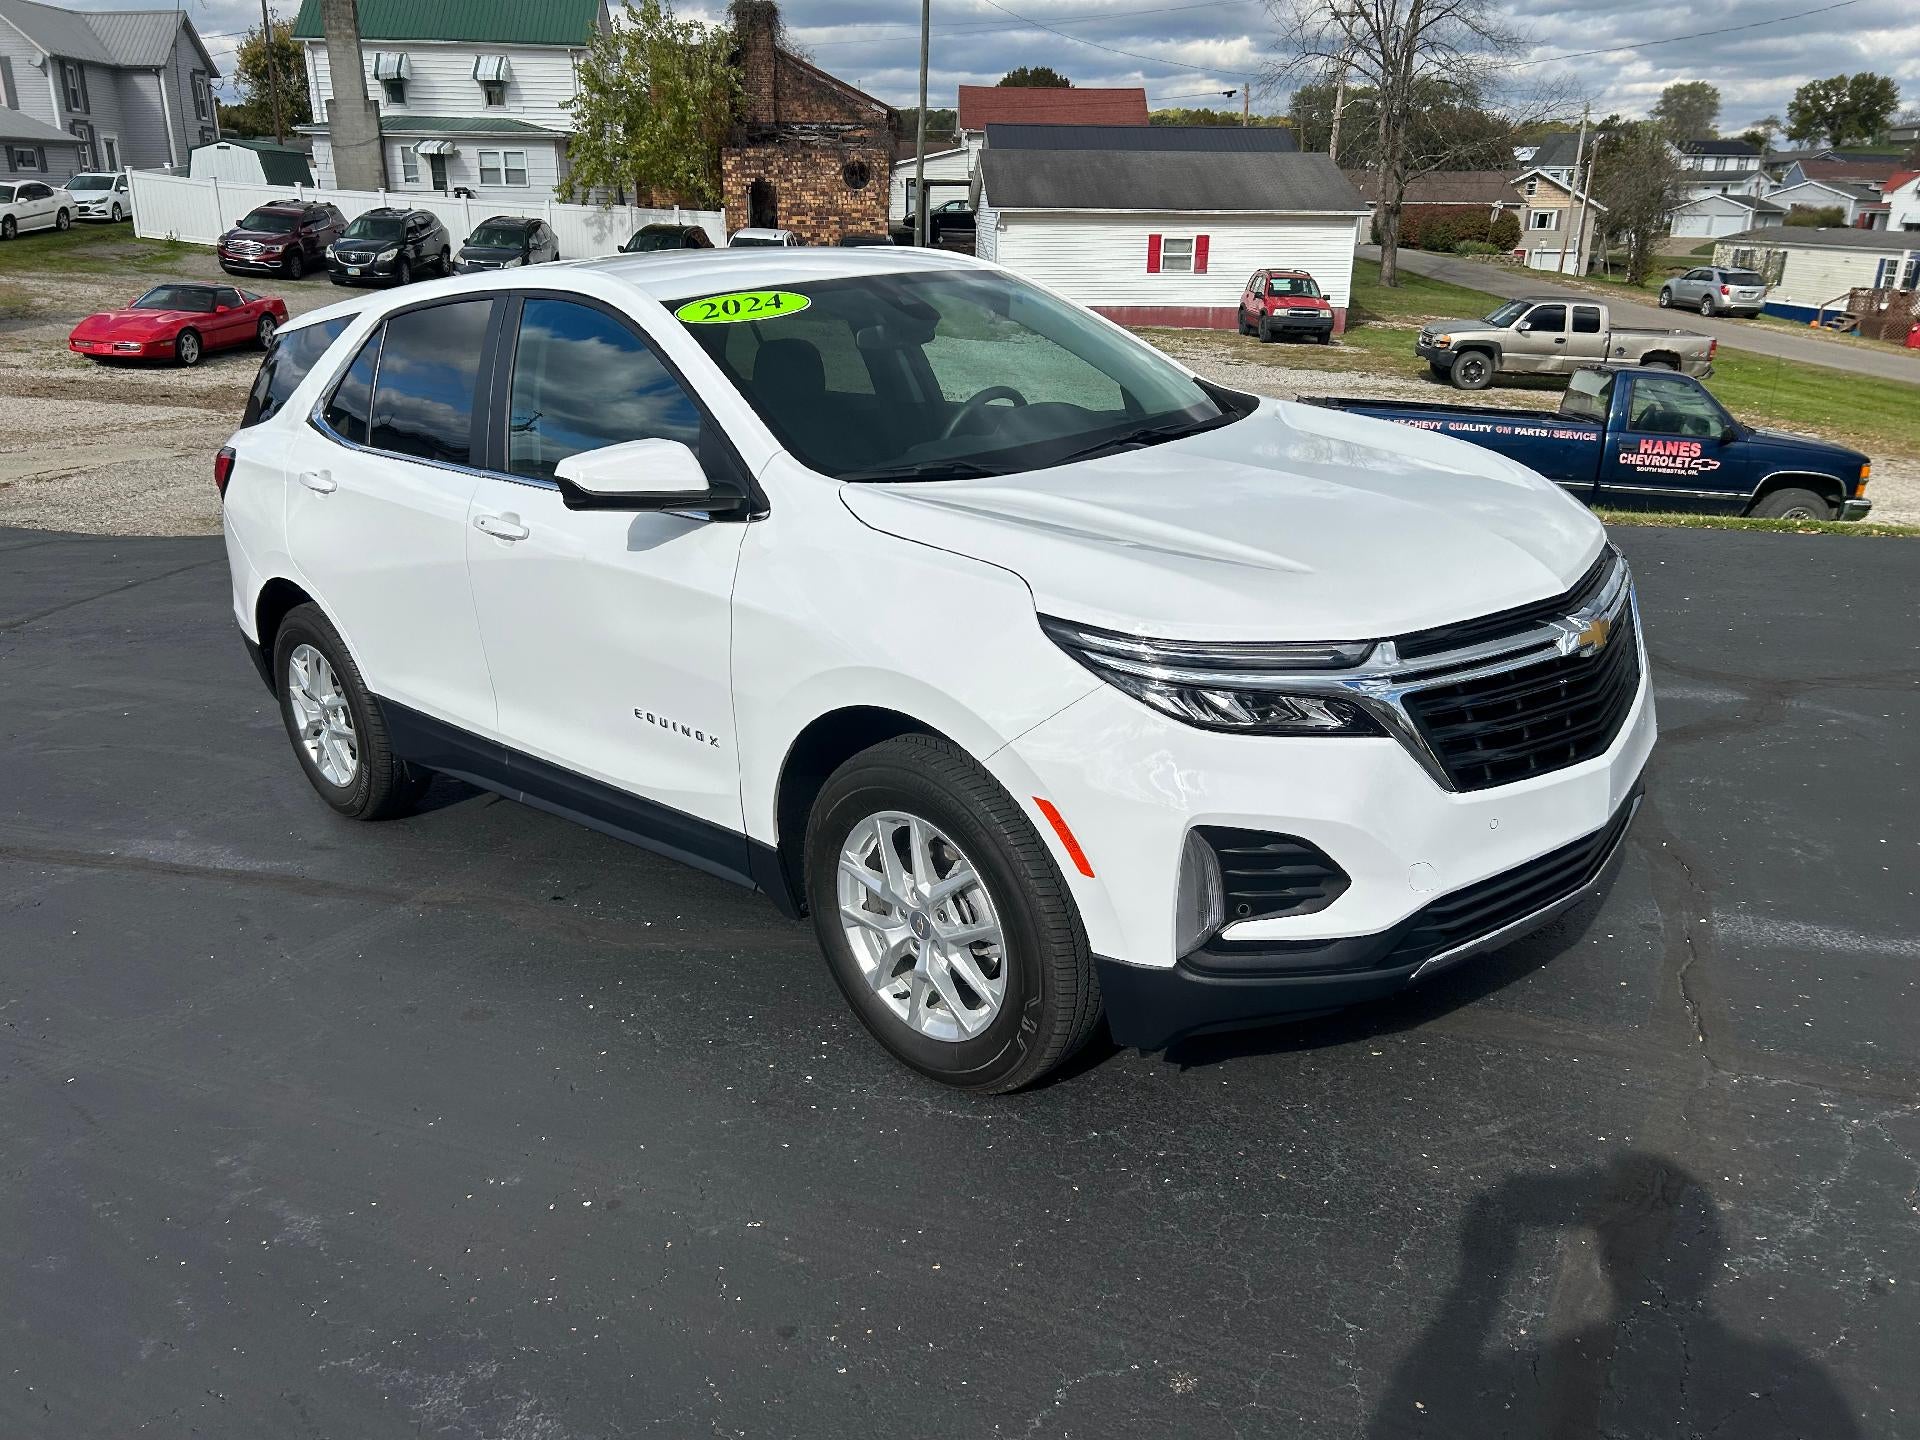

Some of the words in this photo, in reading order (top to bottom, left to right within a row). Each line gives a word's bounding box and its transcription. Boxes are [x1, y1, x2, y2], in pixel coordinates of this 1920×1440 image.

[700, 293, 783, 320] 2024
[1448, 422, 1493, 433] QUALITY
[1495, 425, 1512, 434] GM
[1639, 439, 1702, 458] HANES
[1619, 453, 1692, 469] CHEVROLET
[634, 708, 720, 748] EQUINOX
